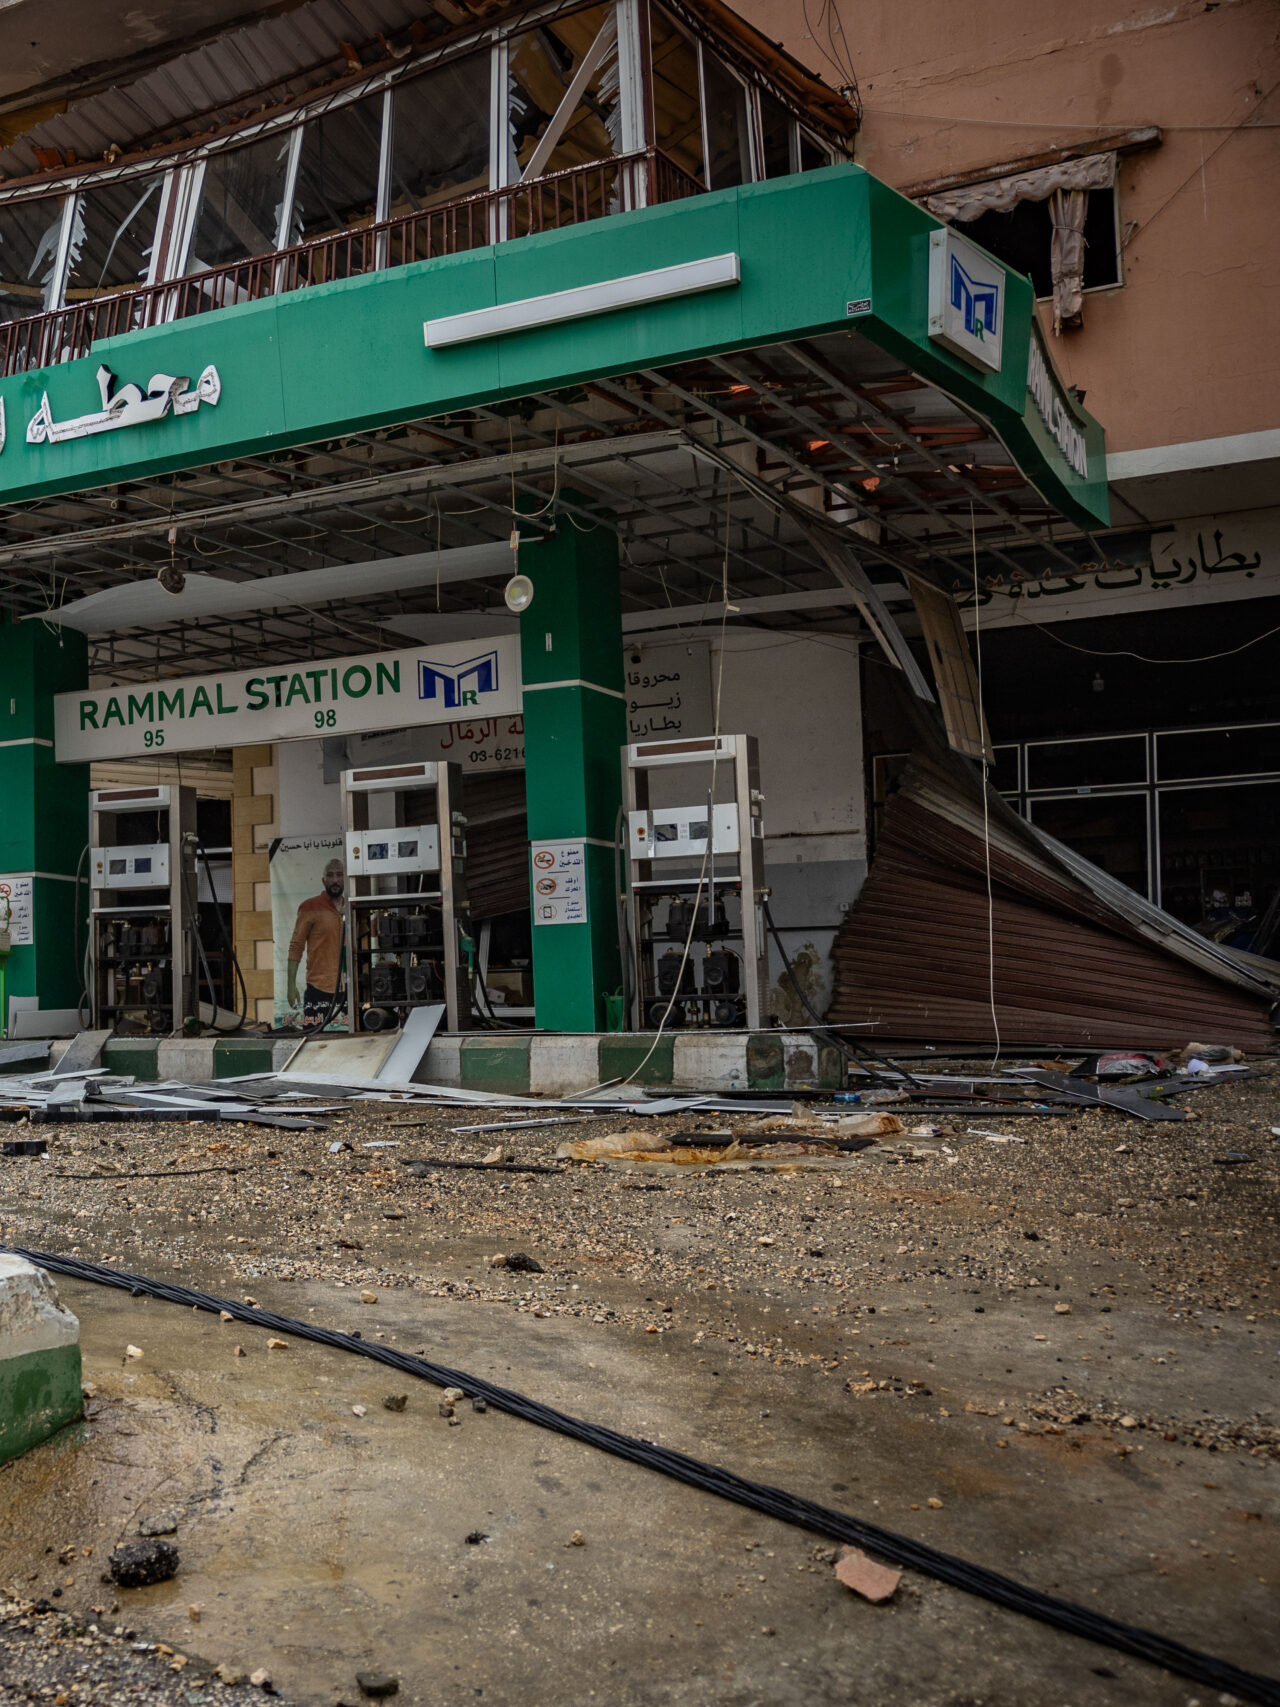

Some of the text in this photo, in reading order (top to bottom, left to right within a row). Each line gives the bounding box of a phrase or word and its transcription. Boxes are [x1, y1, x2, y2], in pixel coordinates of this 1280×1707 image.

[628, 671, 681, 688] محروقا
[79, 683, 239, 731] RAMMAL
[245, 660, 401, 711] STATION
[629, 691, 682, 714] زيو
[314, 710, 337, 729] 98
[629, 715, 682, 737] بطاريا
[143, 729, 165, 748] 95
